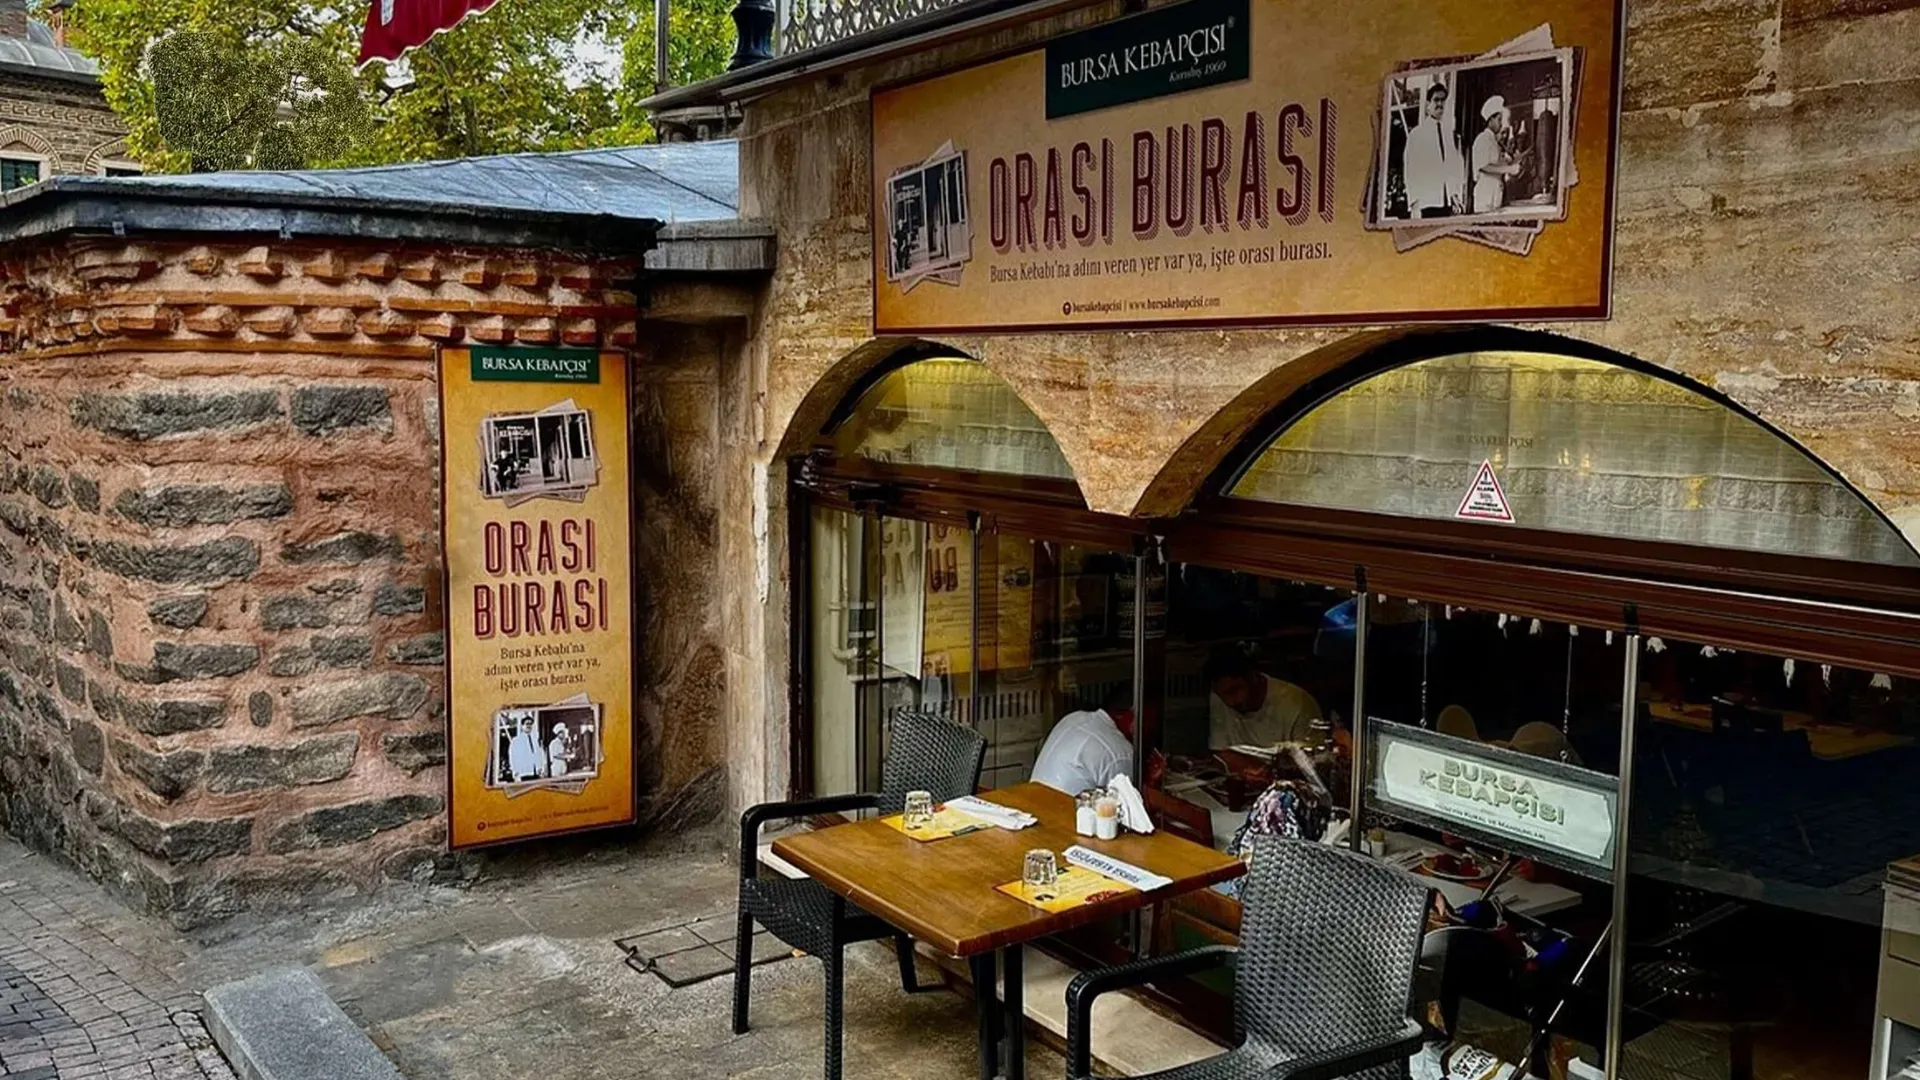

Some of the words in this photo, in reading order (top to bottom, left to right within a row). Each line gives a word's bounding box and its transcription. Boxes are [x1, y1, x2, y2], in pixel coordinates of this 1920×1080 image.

[1061, 52, 1120, 88] BURSA
[990, 137, 1114, 254] ORASI
[1132, 98, 1338, 241] BURASI
[990, 265, 1018, 283] Bursa
[1073, 258, 1101, 277] adını
[1104, 257, 1136, 275] veren
[1140, 255, 1160, 277] yer
[1164, 254, 1185, 270] var
[1188, 252, 1207, 273] ya,
[1211, 247, 1236, 272] işte
[1239, 246, 1275, 265] orası
[1280, 240, 1332, 262] burası.
[482, 357, 524, 370] BURSA
[485, 518, 596, 577] ORASI
[474, 577, 608, 640] BURASI
[500, 647, 531, 660] Bursa
[515, 662, 544, 674] veren
[547, 660, 564, 673] yer
[567, 658, 583, 669] var
[1444, 760, 1539, 800] BURSA
